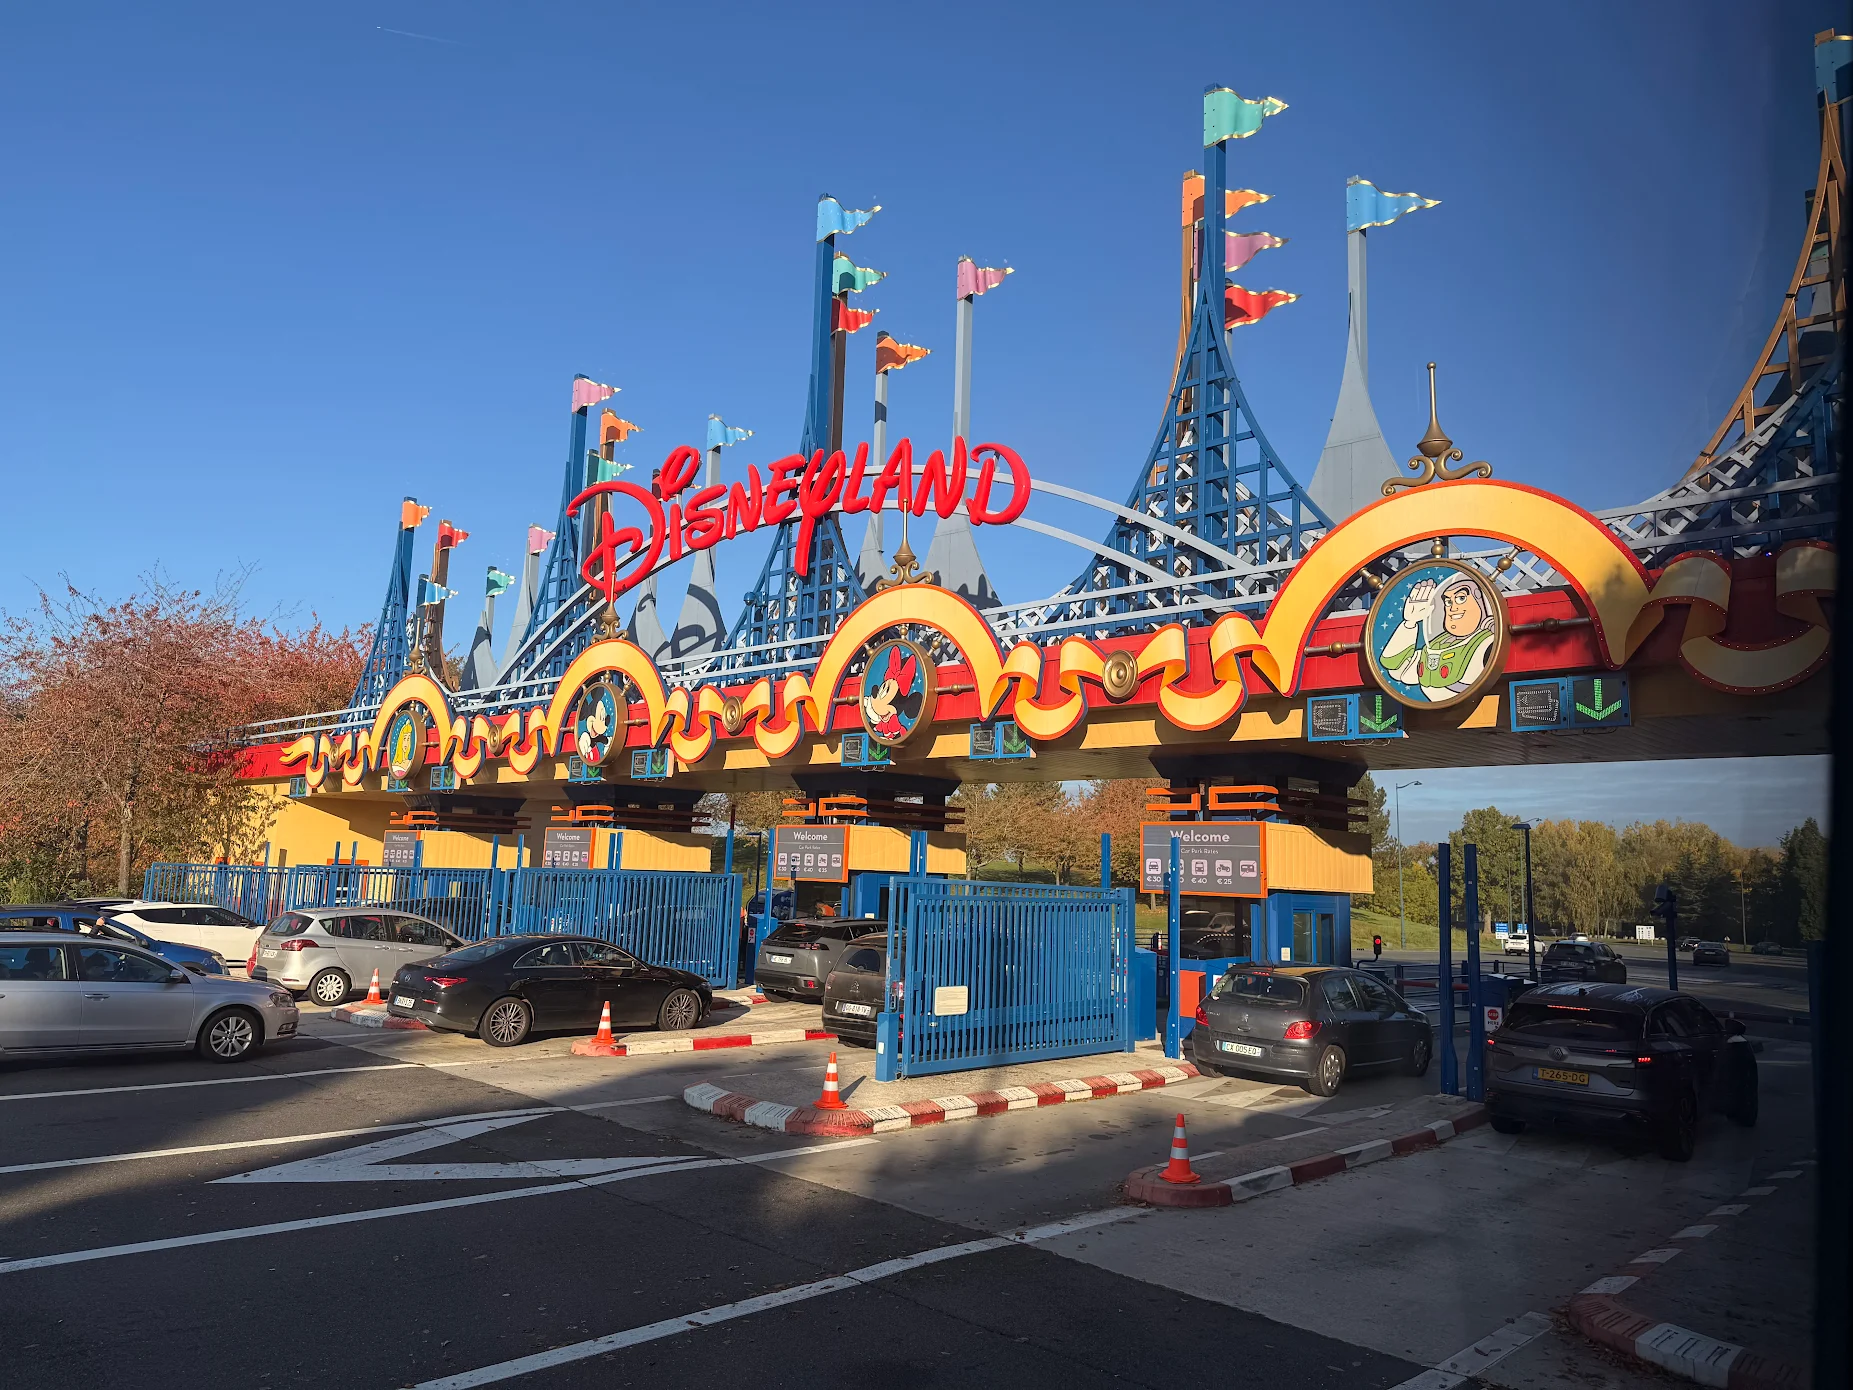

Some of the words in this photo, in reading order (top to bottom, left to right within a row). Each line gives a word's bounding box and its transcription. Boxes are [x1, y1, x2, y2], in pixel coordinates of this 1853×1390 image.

[556, 832, 580, 841] Welcome
[793, 830, 828, 841] Welcome
[1170, 829, 1230, 842] Welcome
